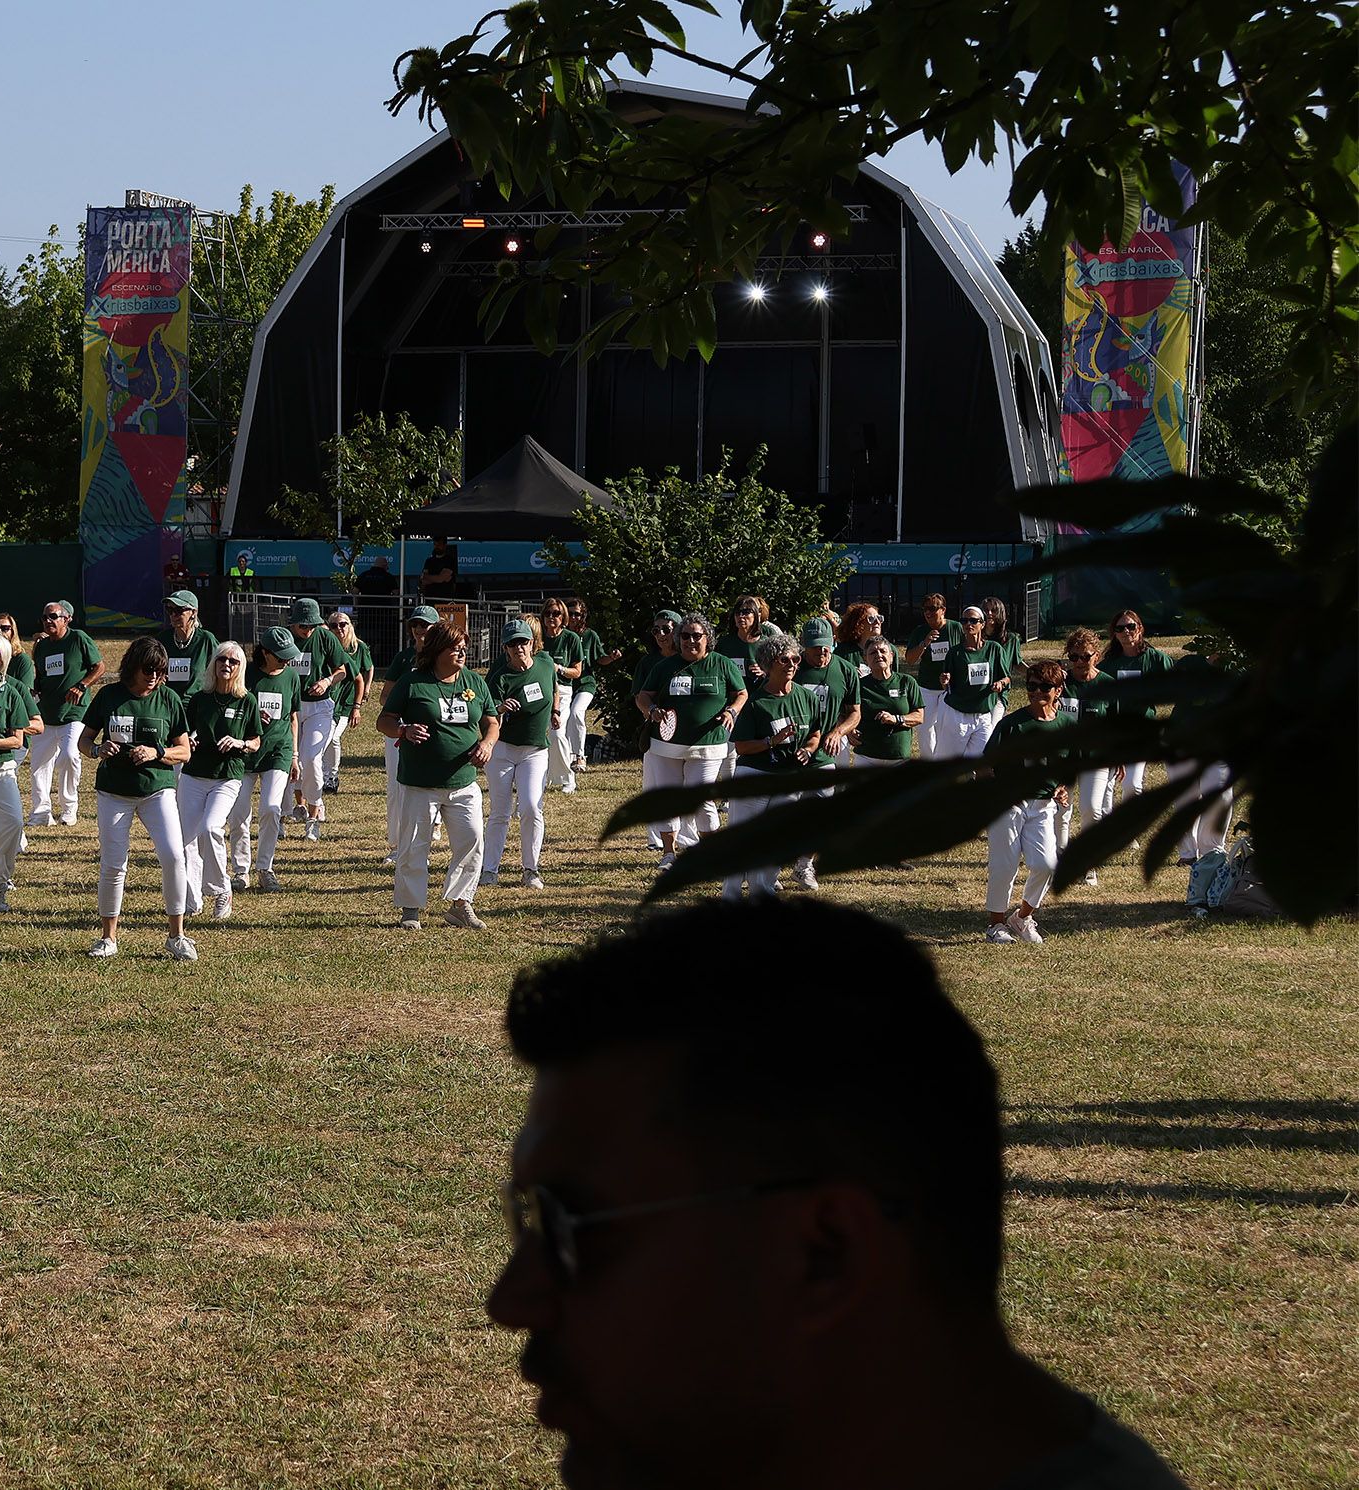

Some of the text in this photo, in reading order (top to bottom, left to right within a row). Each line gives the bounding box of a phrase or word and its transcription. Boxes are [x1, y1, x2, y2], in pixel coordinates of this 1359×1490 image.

[107, 220, 171, 249] PORTA
[107, 249, 171, 273] MERICA
[256, 554, 297, 562] esmerarte
[47, 660, 62, 669] UNED
[169, 665, 188, 673] UNED
[970, 669, 987, 678] UNED
[260, 701, 279, 710] UNED
[110, 724, 130, 733] UNED
